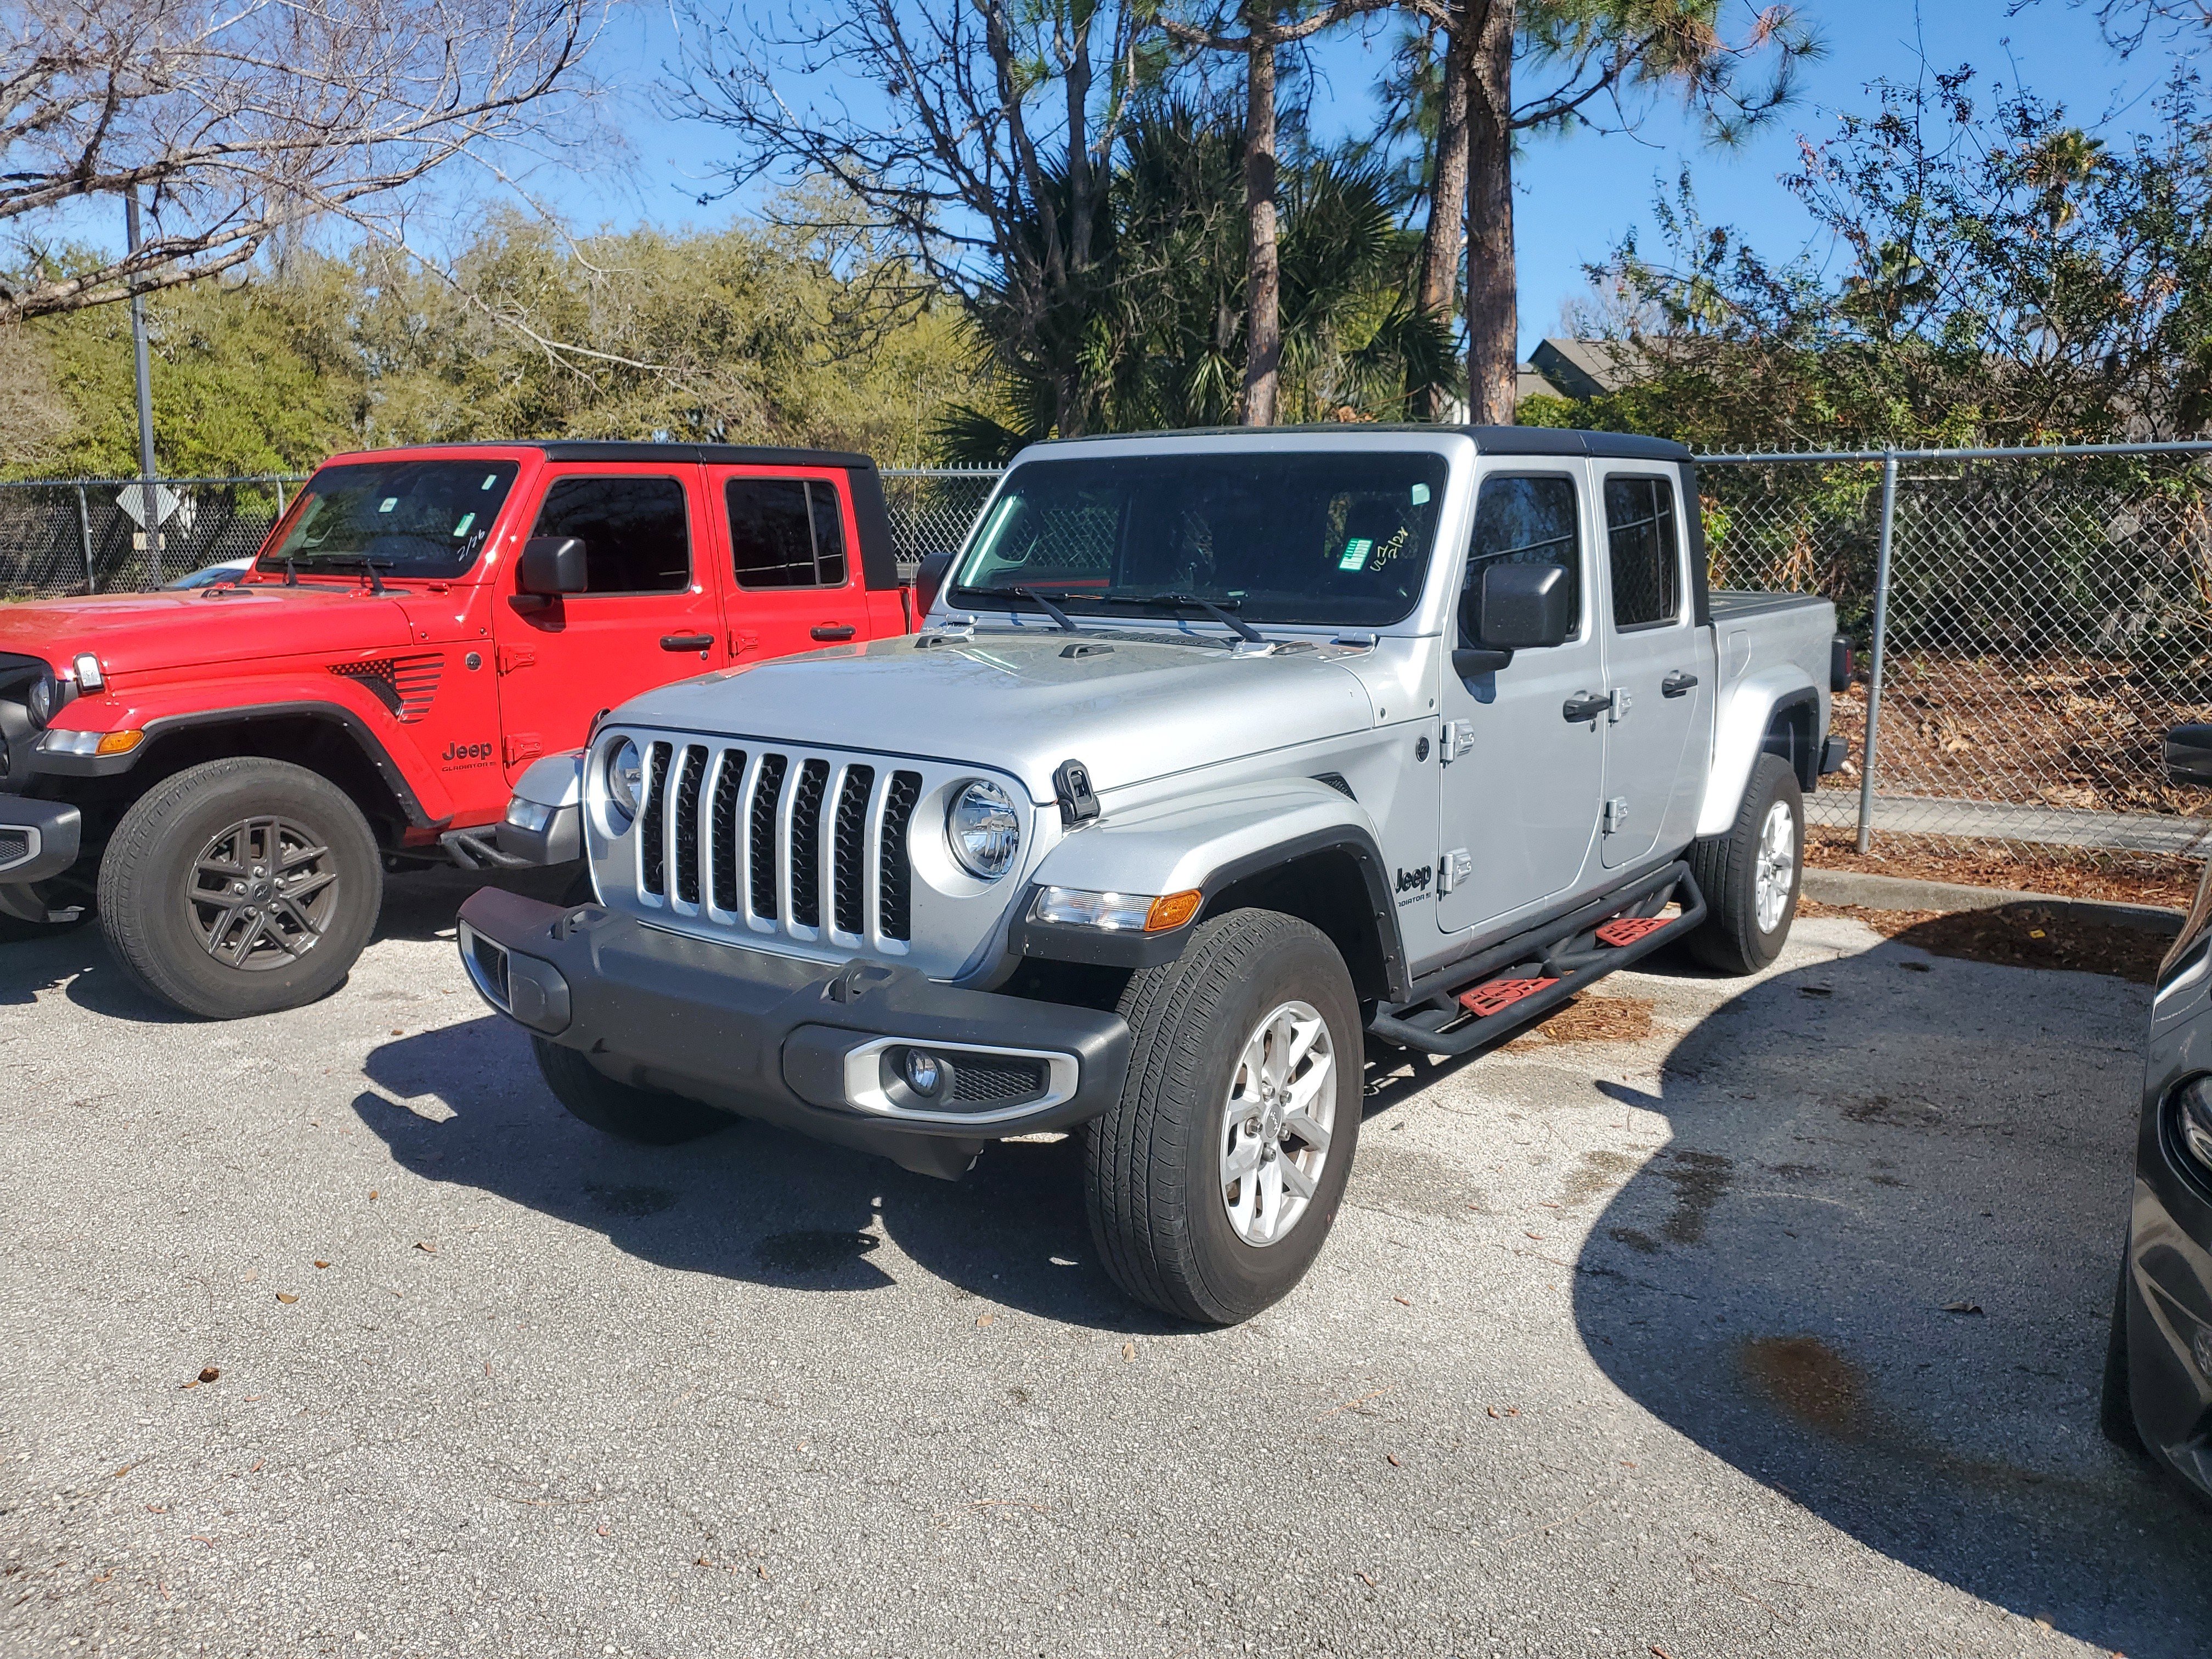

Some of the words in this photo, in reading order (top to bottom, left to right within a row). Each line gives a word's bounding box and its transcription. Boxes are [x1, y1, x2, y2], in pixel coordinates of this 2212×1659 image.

[442, 742, 492, 760] Jeep
[442, 762, 488, 771] GLADIATOR
[1394, 865, 1431, 894] Jeep
[1398, 894, 1425, 907] ADIATOR
